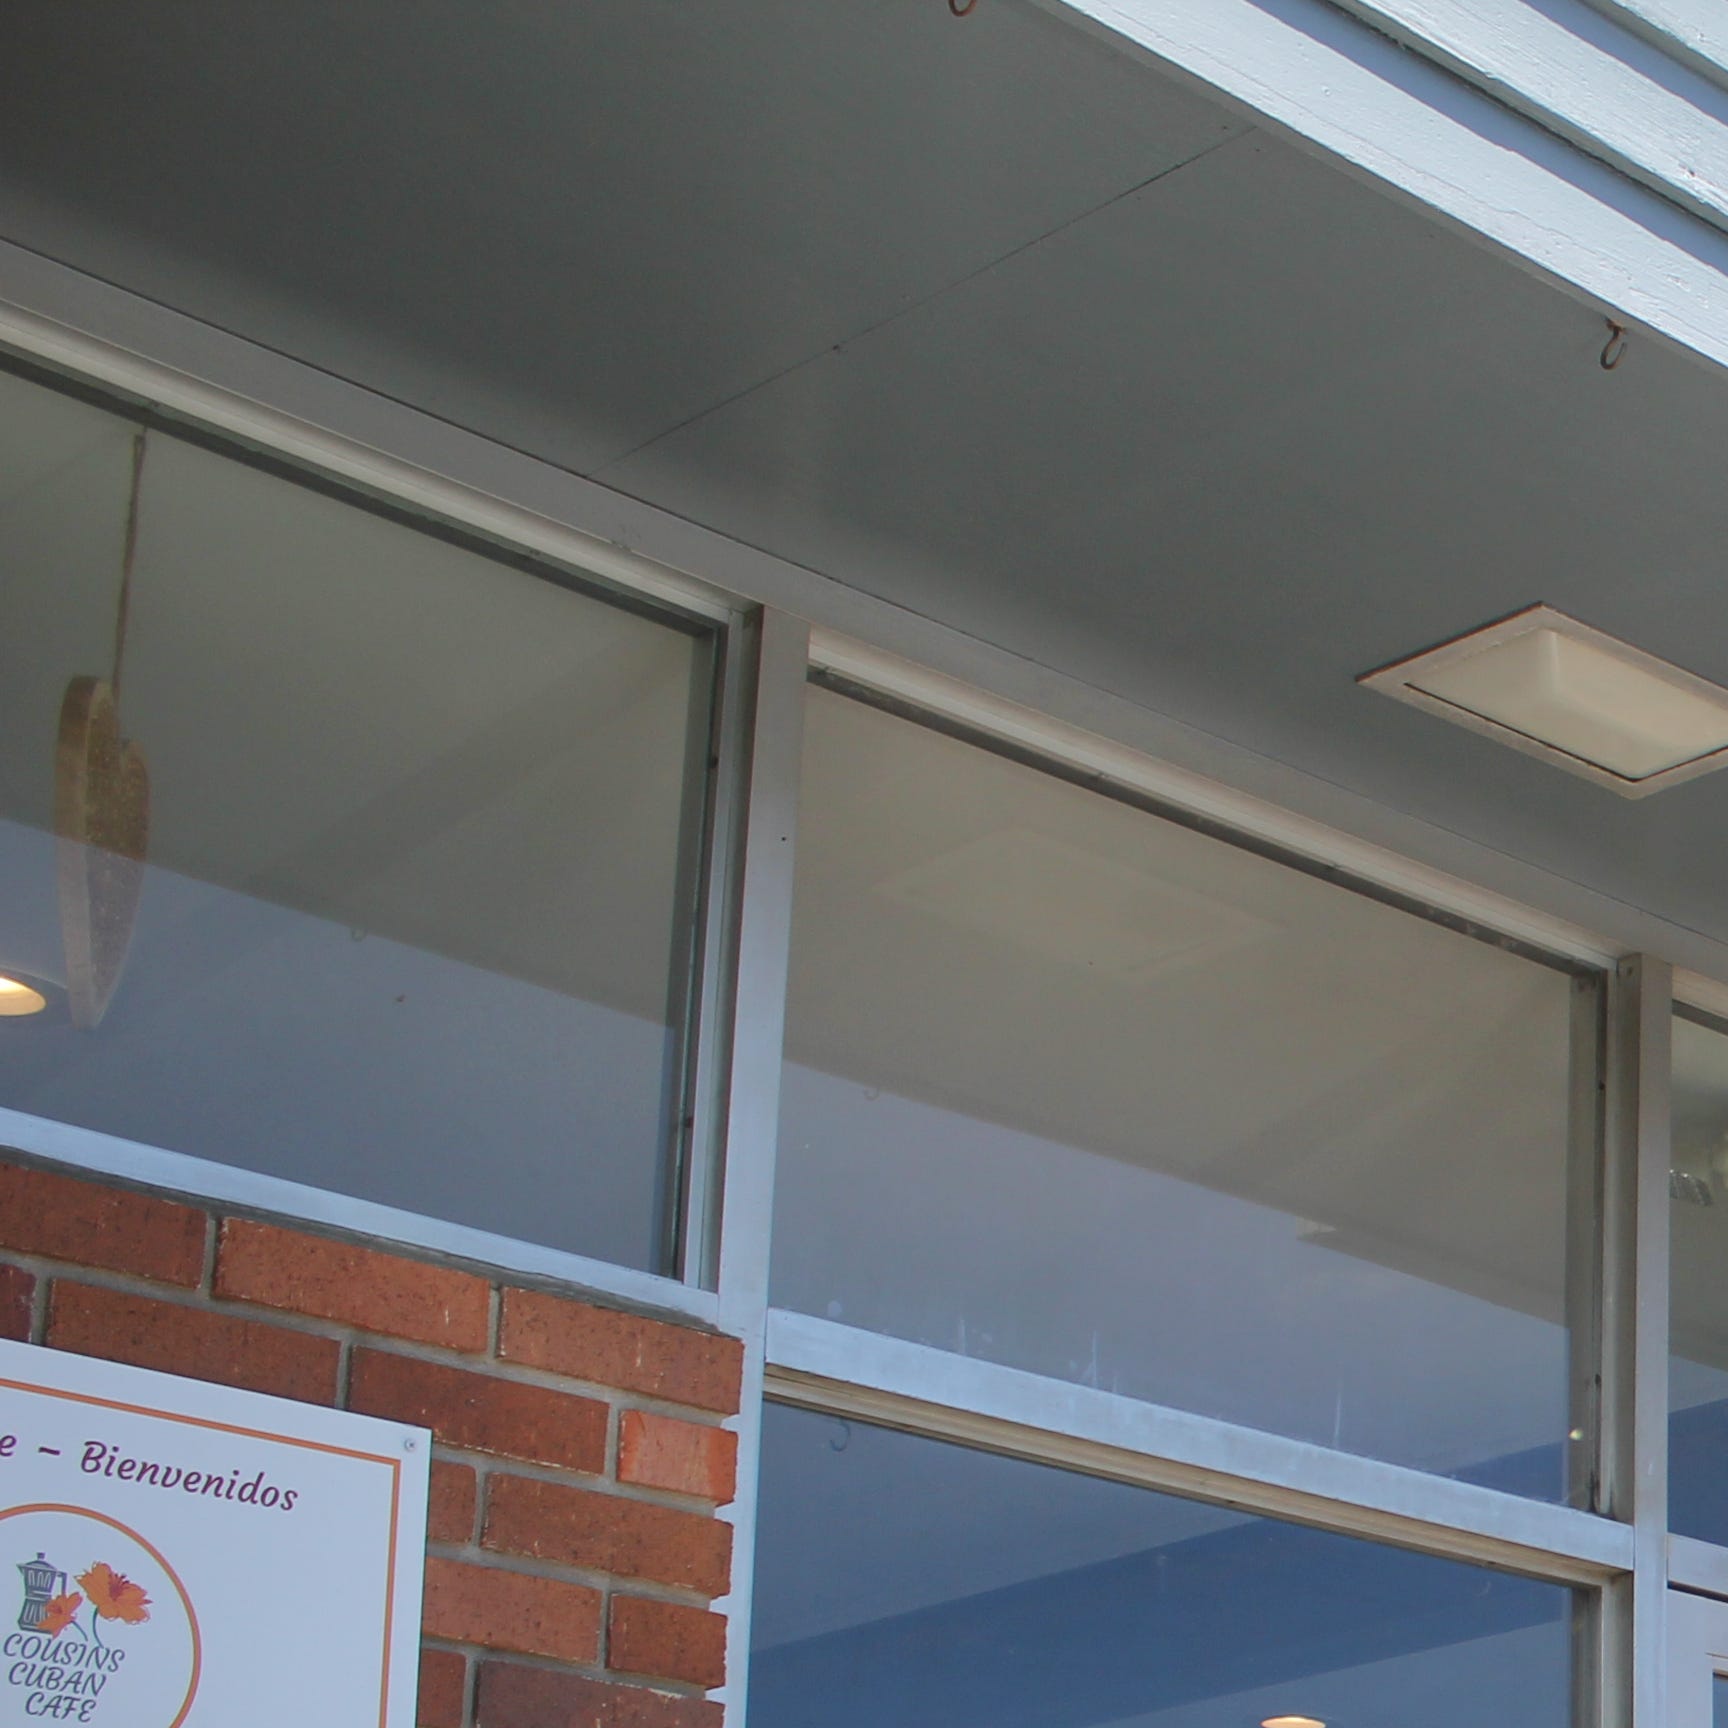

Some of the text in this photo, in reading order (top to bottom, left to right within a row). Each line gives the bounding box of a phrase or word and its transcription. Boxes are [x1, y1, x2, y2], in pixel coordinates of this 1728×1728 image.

[80, 1440, 299, 1511] Bienvenidos
[2, 1633, 126, 1673] COUSINS
[8, 1661, 107, 1697] CUBAN
[25, 1691, 97, 1723] CAFE
